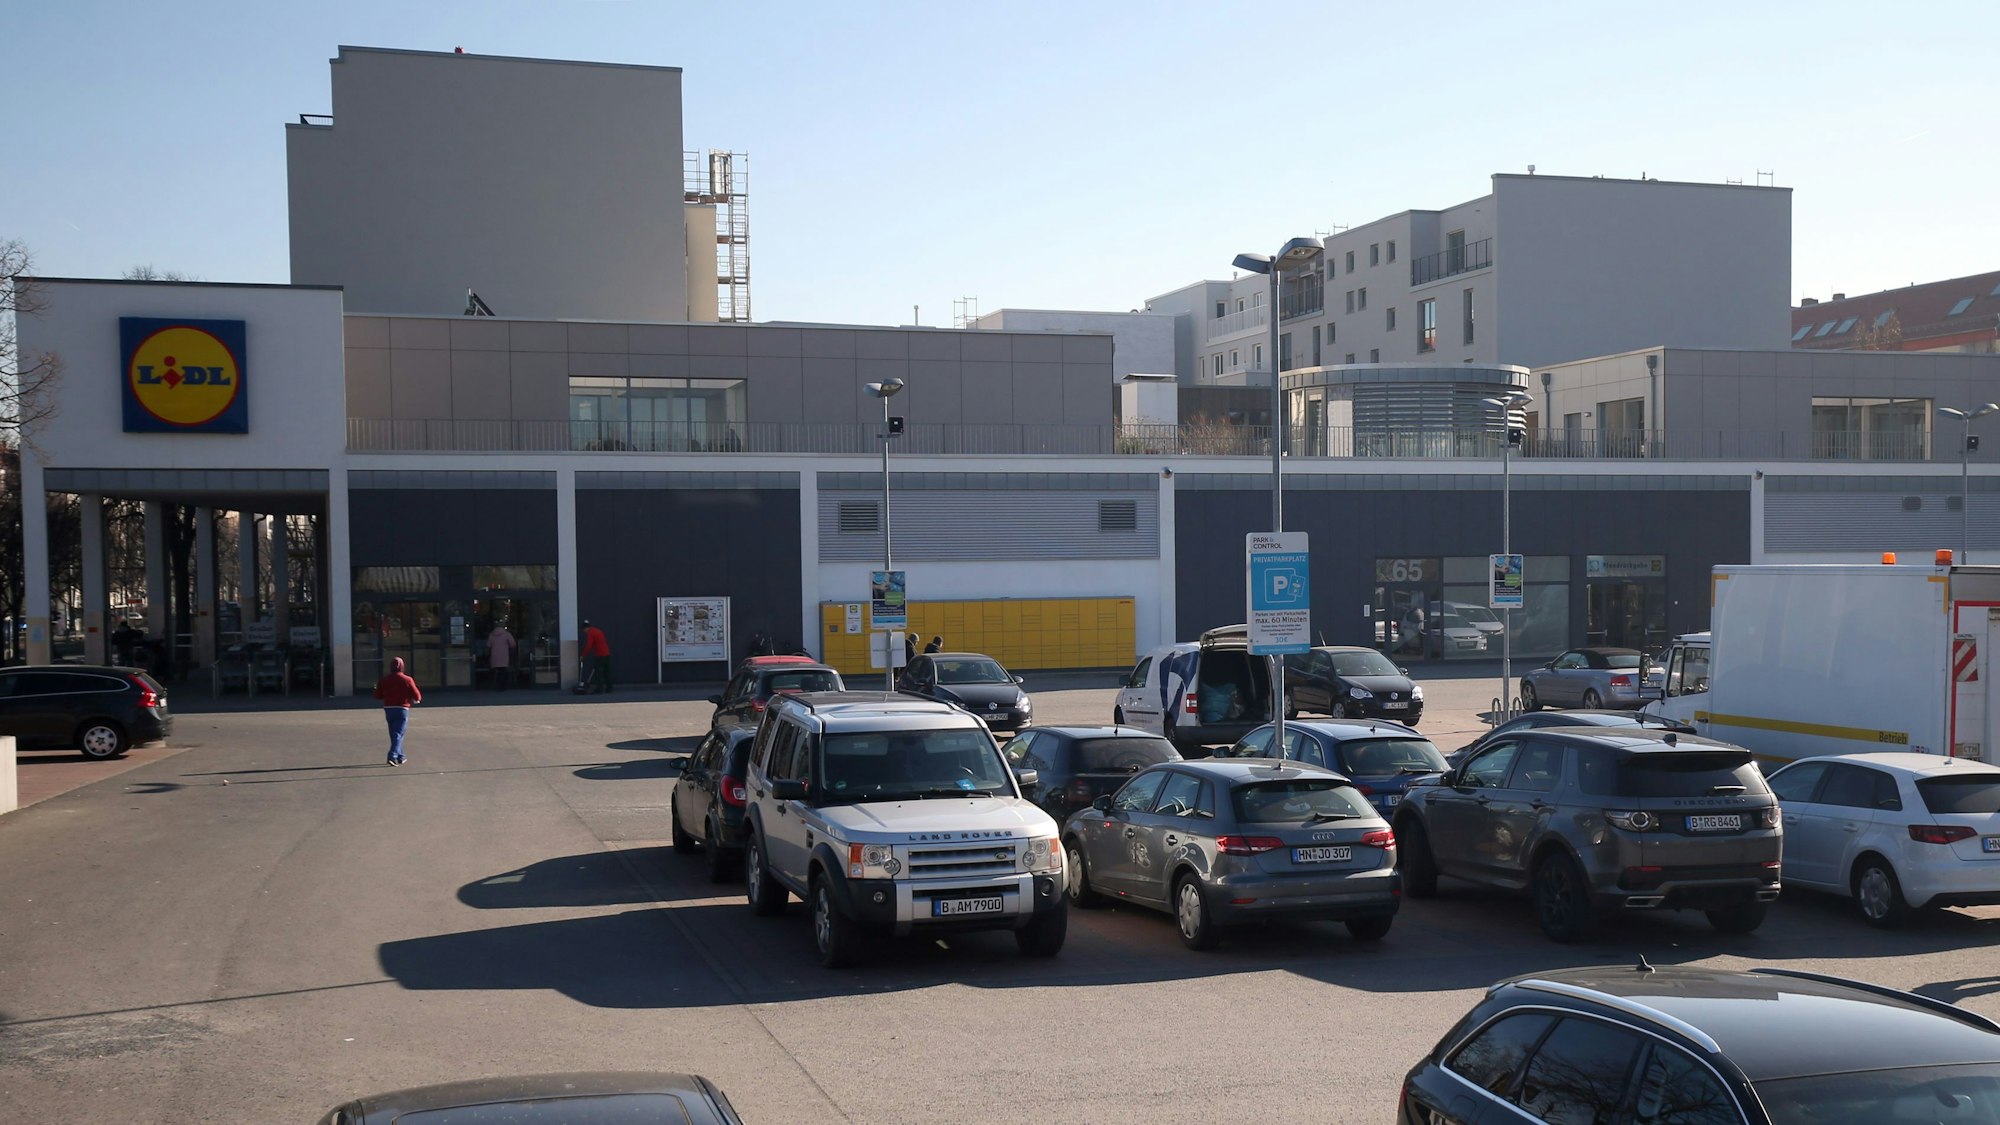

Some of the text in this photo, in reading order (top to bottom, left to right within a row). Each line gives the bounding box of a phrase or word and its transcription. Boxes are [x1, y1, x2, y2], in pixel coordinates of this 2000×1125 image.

[1253, 555, 1306, 563] PRIVATPARKPLATZ
[1392, 559, 1423, 582] 65
[1273, 575, 1289, 595] P
[1879, 731, 1907, 745] Betrieb
[1392, 796, 1397, 804] B
[1674, 798, 1747, 806] DISCOVERY
[1692, 816, 1740, 828] B RG 8461
[961, 831, 1013, 839] ROVER
[1298, 847, 1350, 860] HN JO 307
[942, 899, 1001, 913] B AM 7900
